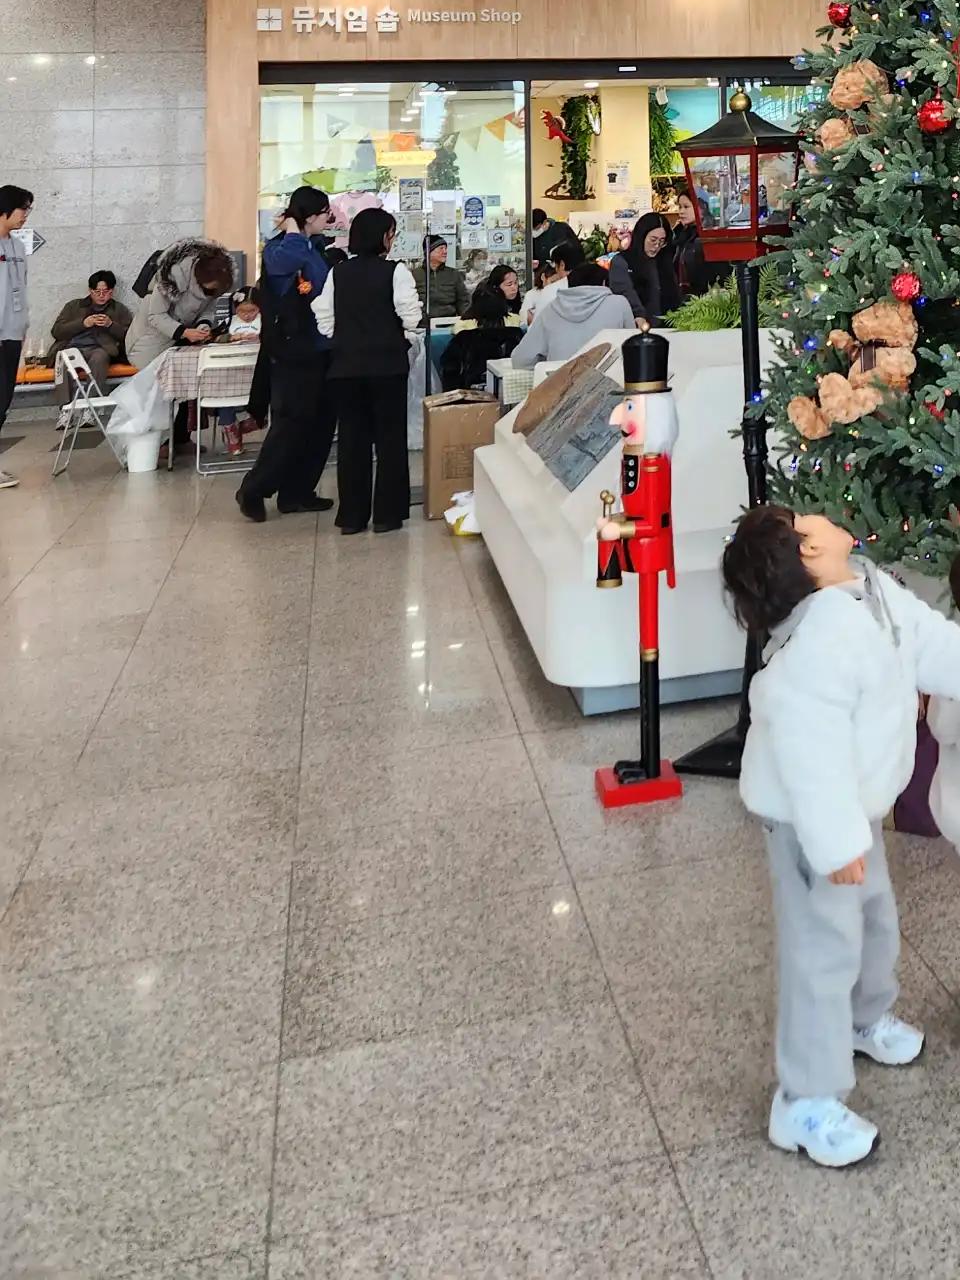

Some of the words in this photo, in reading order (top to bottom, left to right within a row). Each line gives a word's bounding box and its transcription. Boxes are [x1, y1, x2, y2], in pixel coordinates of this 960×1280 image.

[291, 6, 368, 34] 뮤지엄
[374, 5, 400, 34] 숍
[407, 8, 476, 23] Museum
[480, 7, 522, 26] Shop
